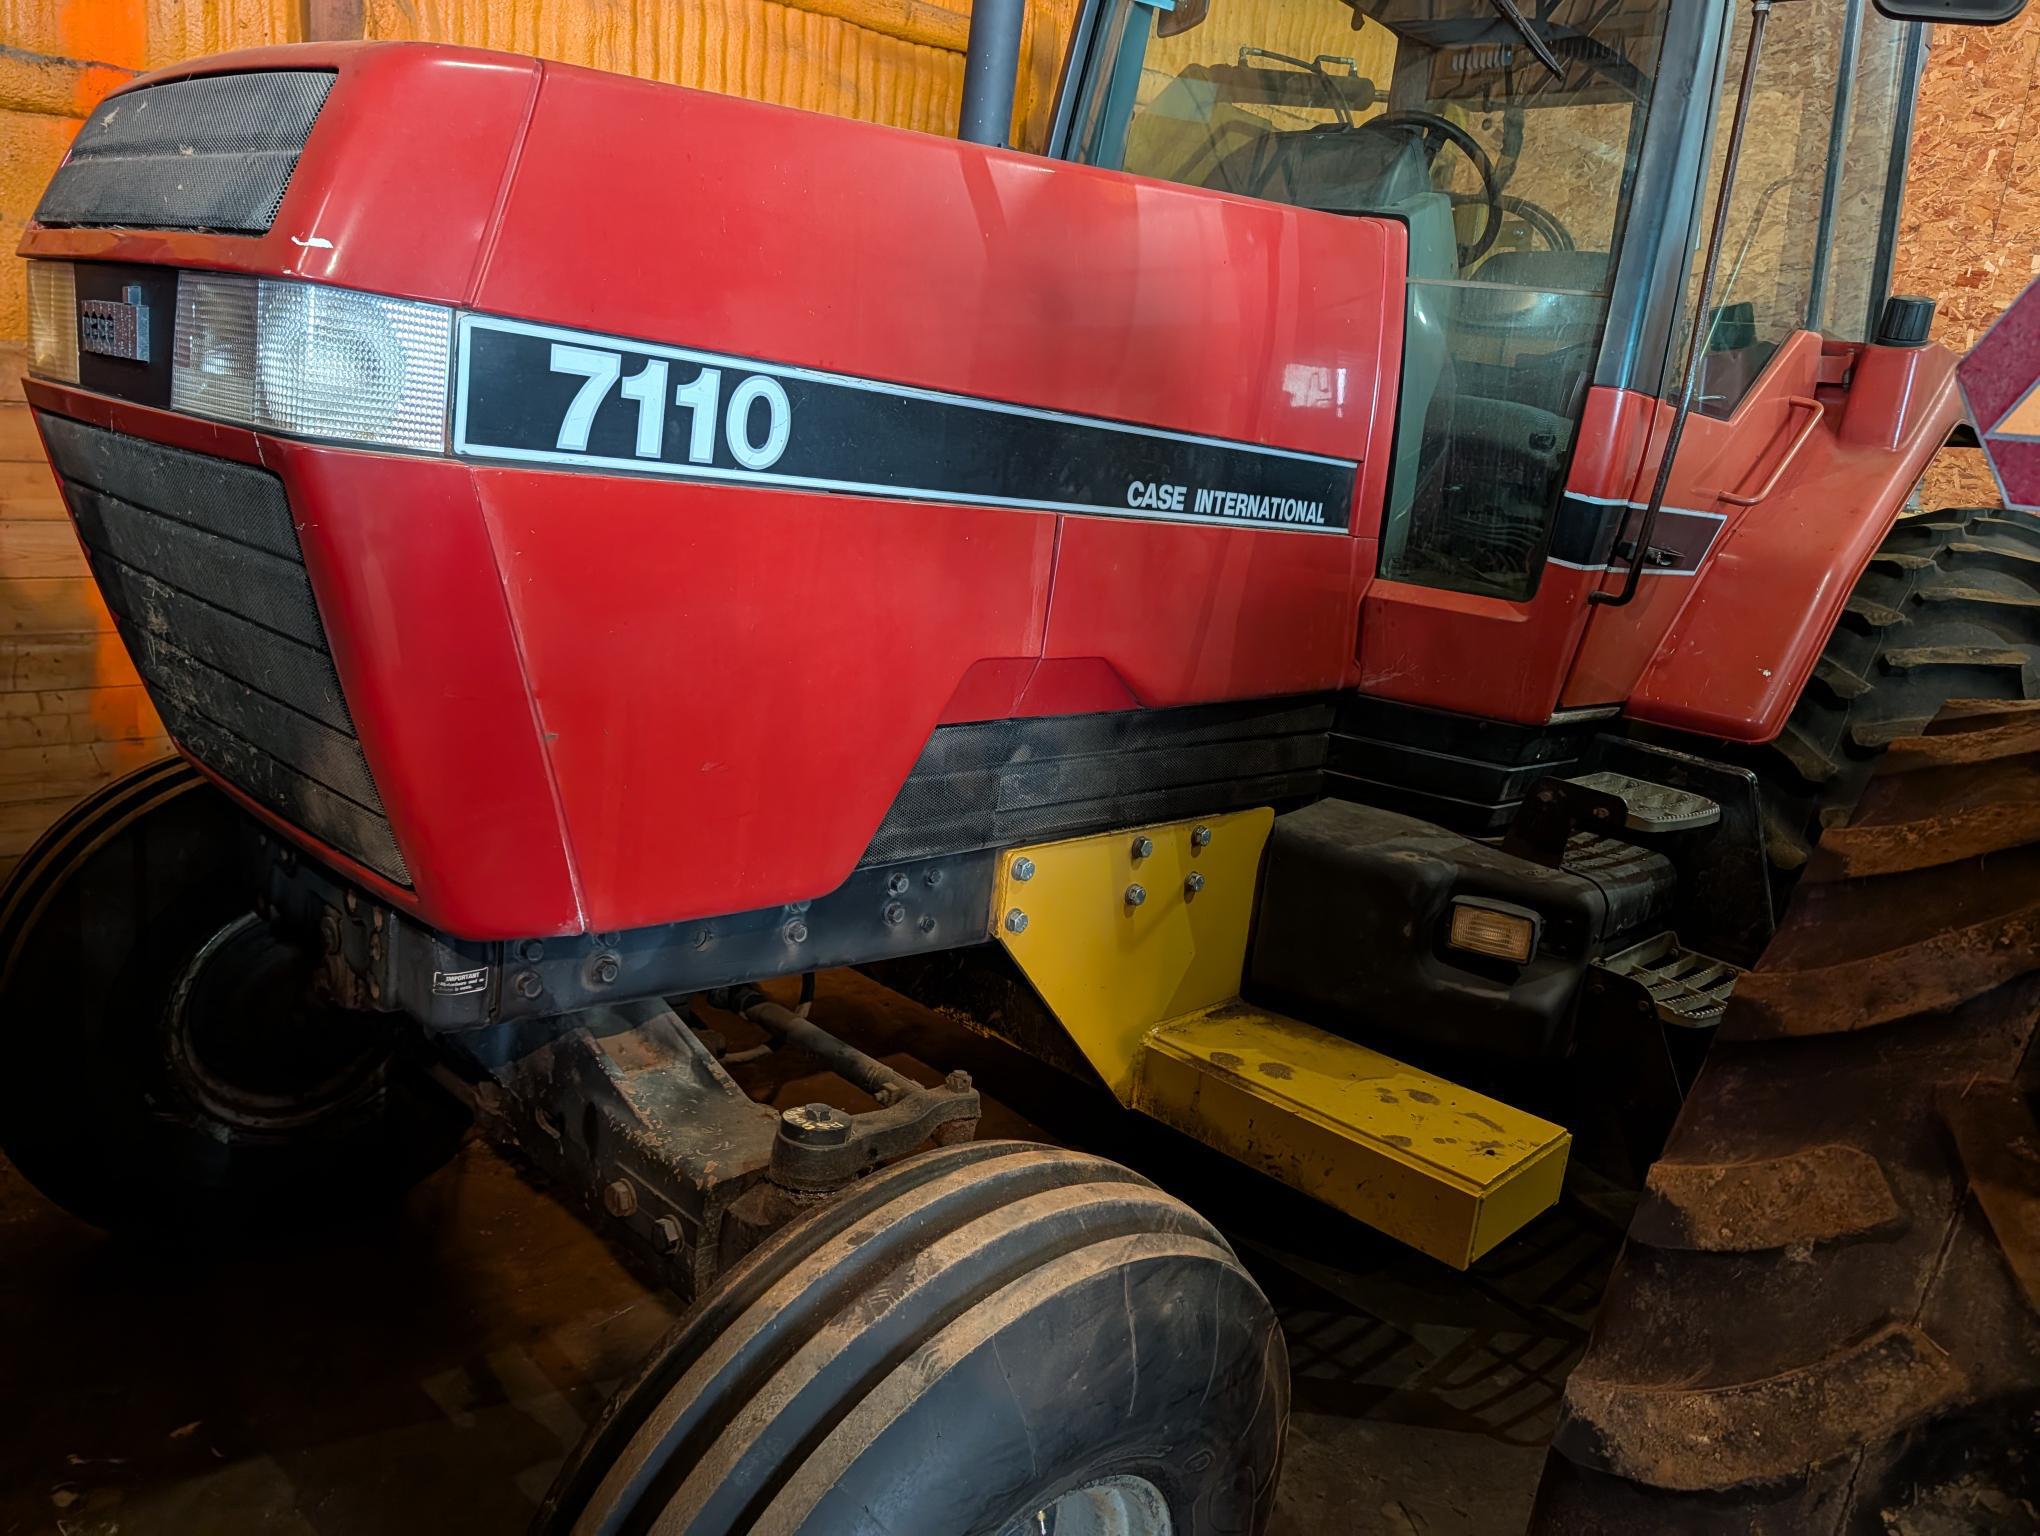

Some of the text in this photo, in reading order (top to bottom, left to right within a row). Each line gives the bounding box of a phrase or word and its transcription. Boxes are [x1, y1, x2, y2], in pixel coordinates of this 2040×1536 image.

[550, 343, 792, 470] 7110
[1127, 480, 1325, 524] CASE INTERNATIONAL
